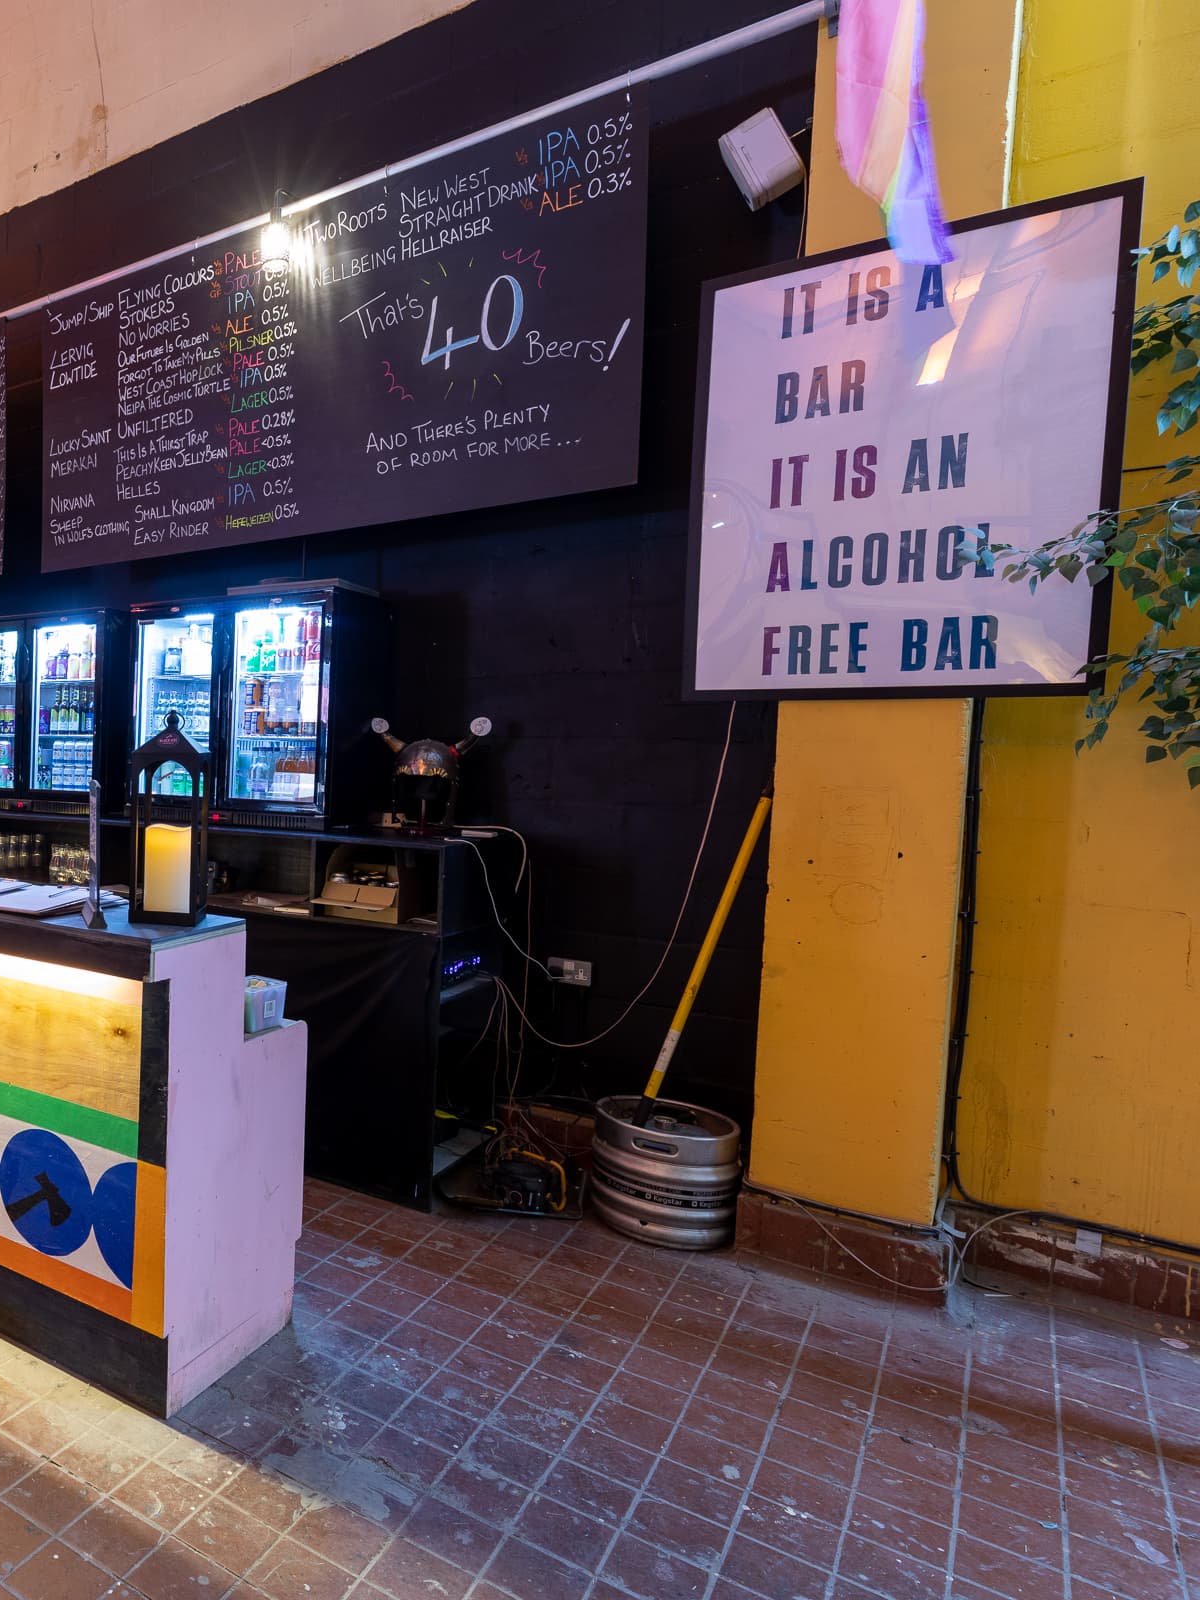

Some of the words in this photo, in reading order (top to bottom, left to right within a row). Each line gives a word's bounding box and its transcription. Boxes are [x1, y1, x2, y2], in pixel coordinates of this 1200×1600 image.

[337, 203, 388, 234] ROOTS
[400, 186, 440, 214] NEW
[444, 167, 490, 195] WEST
[539, 127, 580, 165] IPA
[587, 112, 633, 146] 0.5%
[399, 193, 485, 239] STRAIGHT
[488, 174, 539, 208] DRANK
[544, 156, 580, 190] IPA
[585, 138, 632, 174] 0.5%
[311, 246, 396, 289] WELLBEING
[400, 216, 493, 262] HELLRAISER
[539, 184, 584, 217] ALE
[588, 167, 632, 200] 0.3%
[118, 284, 161, 311] FLYING
[164, 265, 215, 296] COLOURS
[119, 297, 175, 329] STOKERS
[224, 270, 261, 295] STOUT
[781, 281, 822, 339] IT
[845, 265, 891, 325] IS
[915, 264, 944, 312] A
[50, 343, 94, 370] LERVIG
[118, 350, 136, 368] OUR
[136, 345, 163, 364] FUTURE
[165, 340, 174, 353] IS
[176, 332, 210, 350] GOLDEN
[225, 315, 254, 337] ALE
[118, 330, 136, 348] NO
[138, 312, 190, 343] WORRIES
[228, 290, 255, 314] IPA
[339, 291, 424, 340] That's
[421, 274, 524, 370] 40
[50, 360, 98, 390] LOWTIDE
[118, 367, 152, 386] FORGOT
[152, 361, 162, 374] TO
[163, 355, 182, 369] TAKE
[182, 352, 195, 365] MY
[196, 346, 220, 362] PILLS
[230, 329, 274, 354] PILSNER
[522, 318, 631, 372] Beers!
[118, 384, 144, 402] WEST
[146, 373, 179, 395] COAST
[179, 368, 198, 386] HOP
[199, 362, 223, 381] LOCK
[118, 399, 145, 417] NEIPA
[146, 395, 162, 409] THE
[163, 389, 192, 406] COSMIC
[192, 377, 231, 397] TURTLE
[240, 367, 263, 388] IPA
[774, 359, 866, 425] BAR
[50, 438, 81, 457] LUCKY
[81, 429, 112, 448] SAINT
[114, 446, 136, 463] THIS
[138, 442, 147, 458] IS
[157, 435, 185, 452] THIRST
[186, 429, 209, 446] TRAP
[262, 409, 295, 430] 0.28%
[117, 408, 194, 440] UNFILTERED
[231, 391, 269, 413] LAGER
[366, 431, 407, 453] AND
[411, 415, 477, 444] THERE'S
[484, 403, 550, 431] PLENTY
[50, 452, 97, 478] MERAKAI
[116, 462, 154, 481] PEACHY
[154, 457, 177, 473] KEEN
[176, 448, 206, 467] JELLY
[206, 444, 228, 462] BEAN
[116, 480, 161, 501] HELLES
[228, 460, 266, 478] LAGER
[376, 456, 402, 474] OF
[410, 448, 458, 468] ROOM
[467, 441, 499, 459] FOR
[769, 454, 809, 509] IT
[833, 444, 877, 501] IS
[901, 432, 969, 494] AN
[50, 493, 95, 514] NIRVANA
[135, 504, 171, 523] SMALL
[172, 497, 215, 516] KINGDOM
[228, 482, 255, 507] IPA
[263, 477, 293, 497] 0.5%
[50, 516, 83, 534] SHEEP
[133, 528, 165, 546] EASY
[170, 522, 209, 539] RINDER
[54, 534, 65, 546] IN
[94, 521, 130, 537] CLOTHING
[760, 621, 868, 676] FREE
[900, 614, 999, 672] BAR
[653, 1195, 683, 1207] Kegstar
